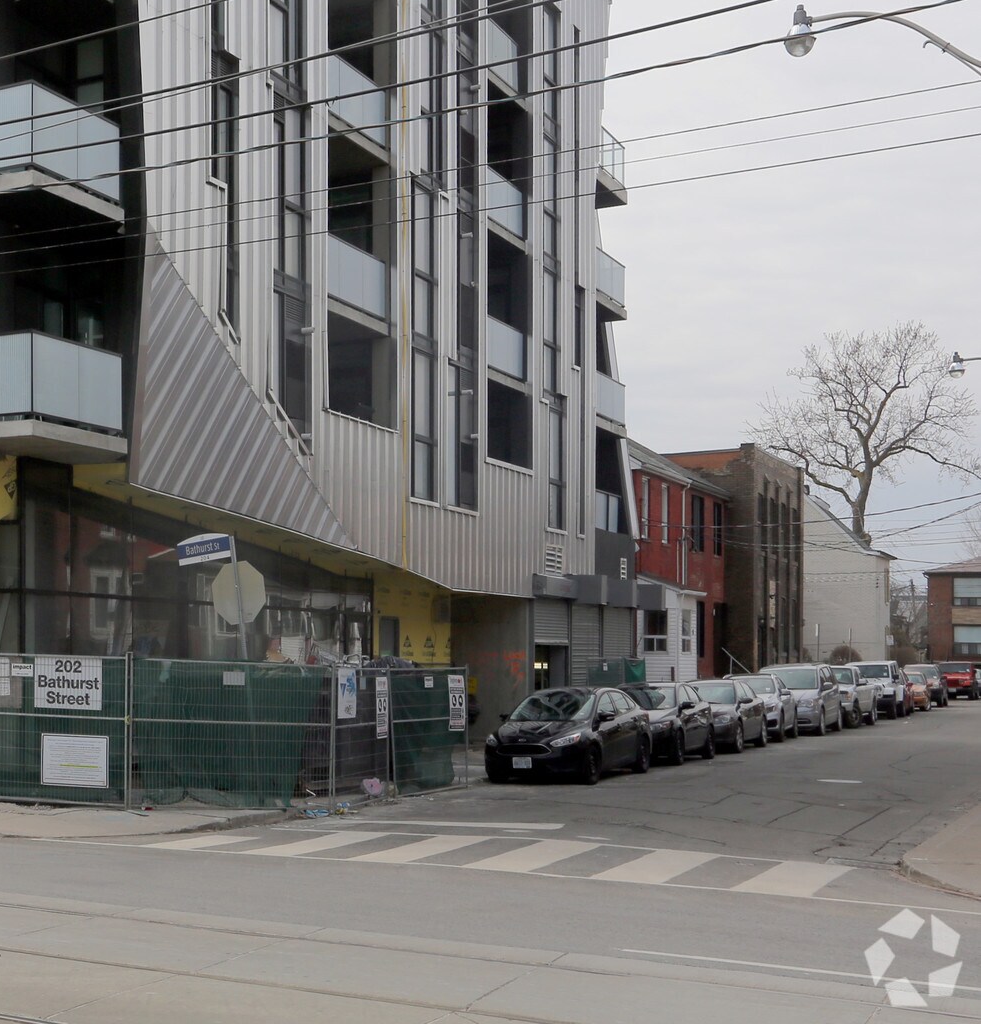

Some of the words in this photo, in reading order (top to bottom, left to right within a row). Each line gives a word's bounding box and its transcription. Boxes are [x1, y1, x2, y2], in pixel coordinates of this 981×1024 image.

[185, 542, 213, 556] Bathurst
[213, 542, 220, 550] St
[54, 660, 82, 674] 202
[37, 675, 99, 690] Bathurst
[46, 691, 90, 706] Street
